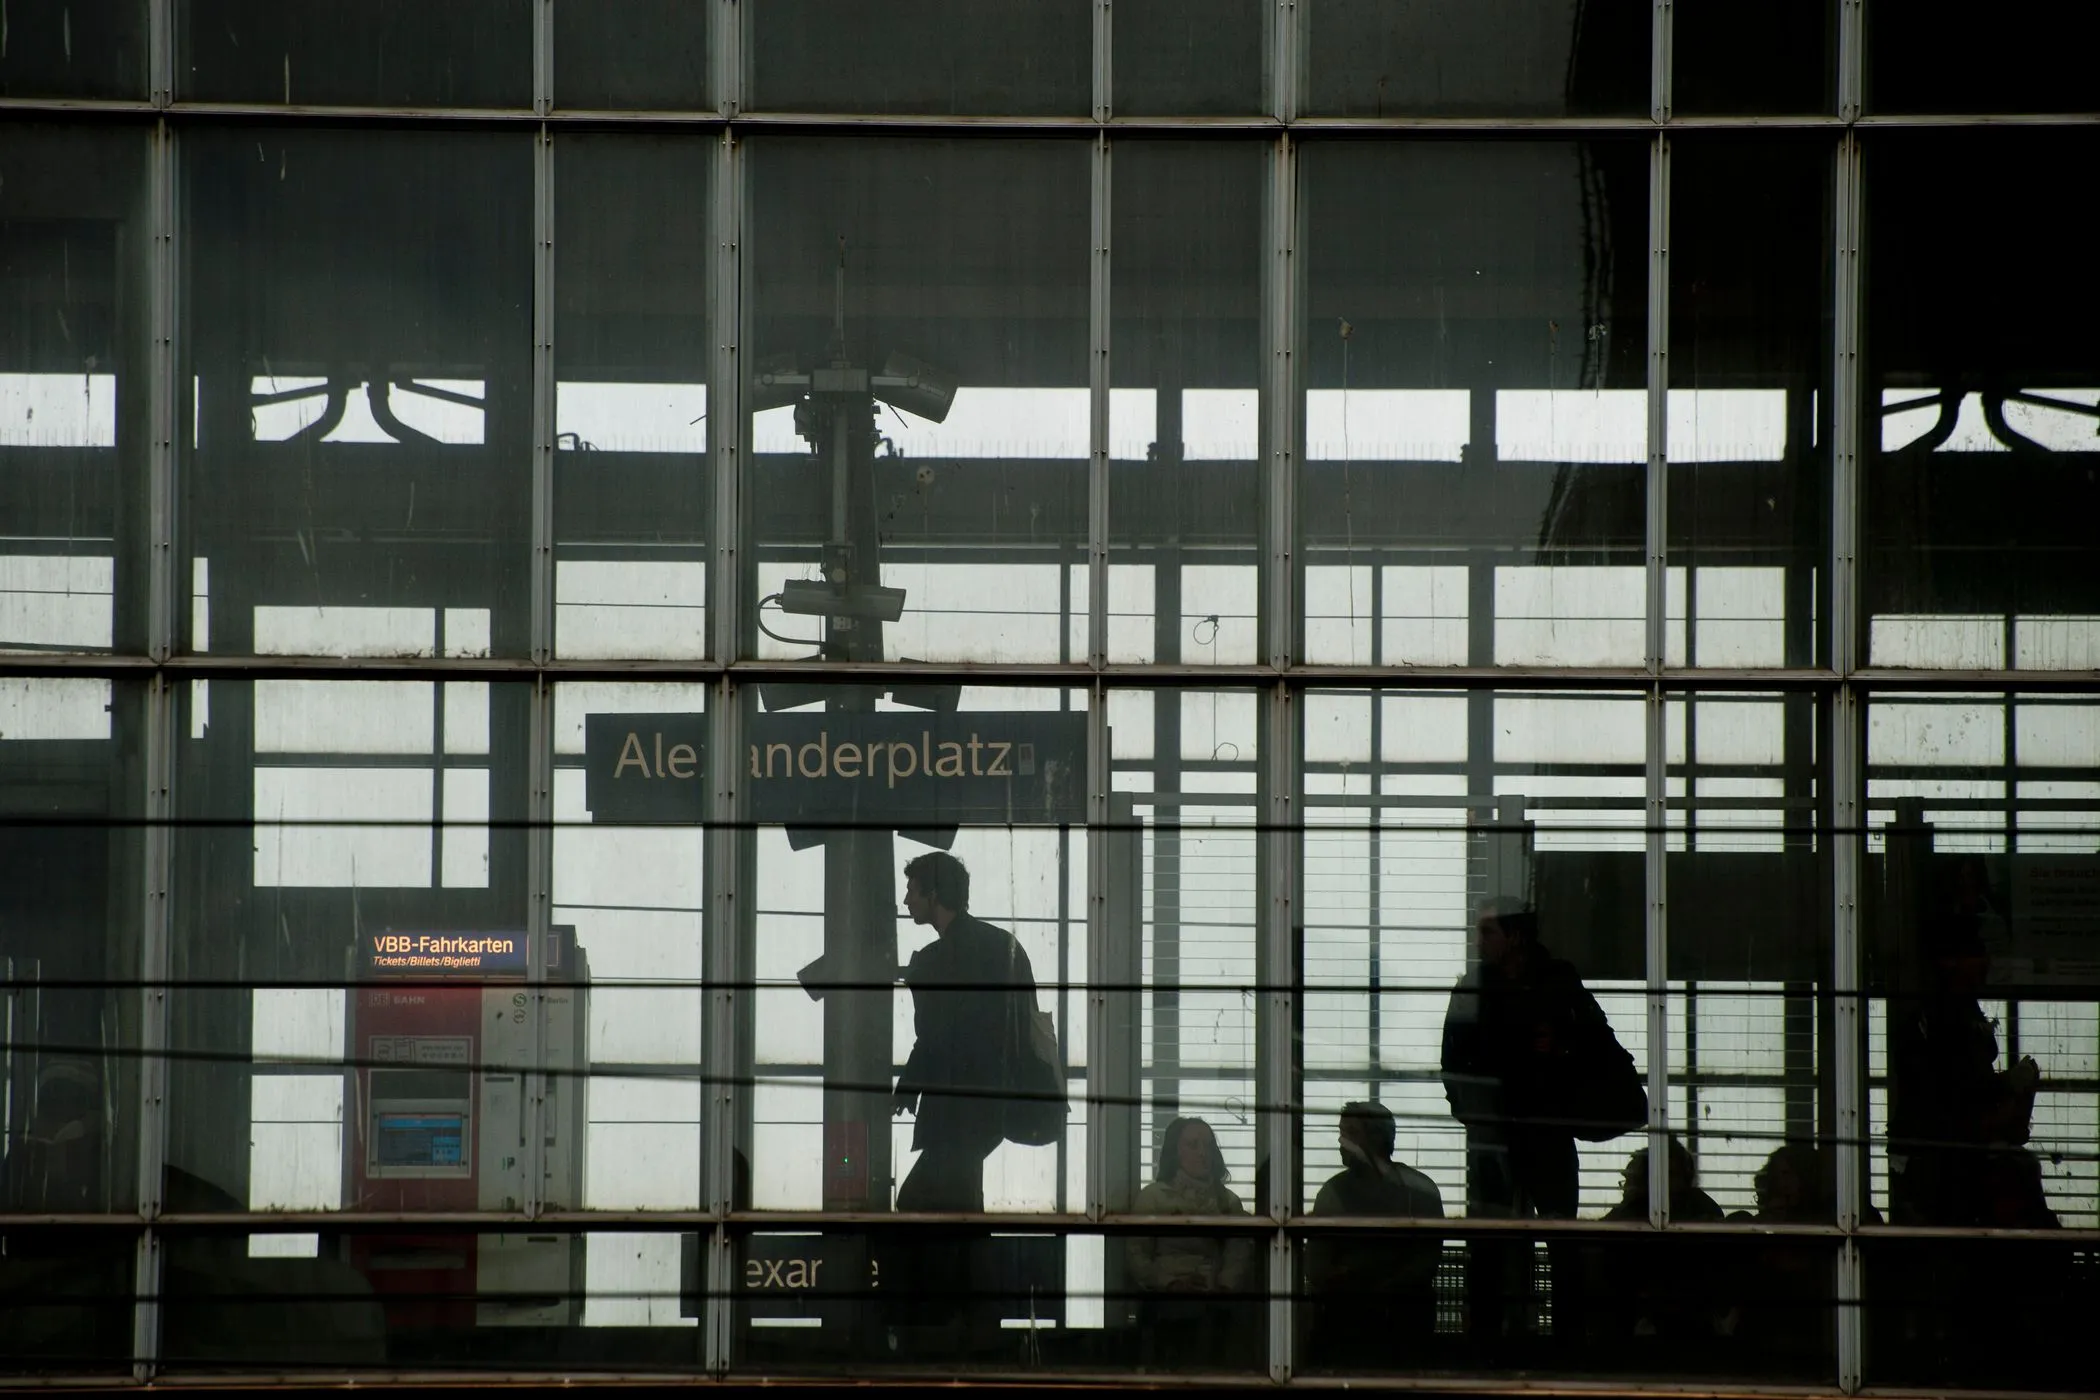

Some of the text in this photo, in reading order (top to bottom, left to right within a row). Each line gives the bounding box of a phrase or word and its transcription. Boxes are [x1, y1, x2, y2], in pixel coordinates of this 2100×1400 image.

[613, 731, 1012, 788] Aleanderplatz
[373, 936, 513, 953] VBB-Fahrkarten
[373, 956, 481, 968] Tickets/Billets/Biglietti
